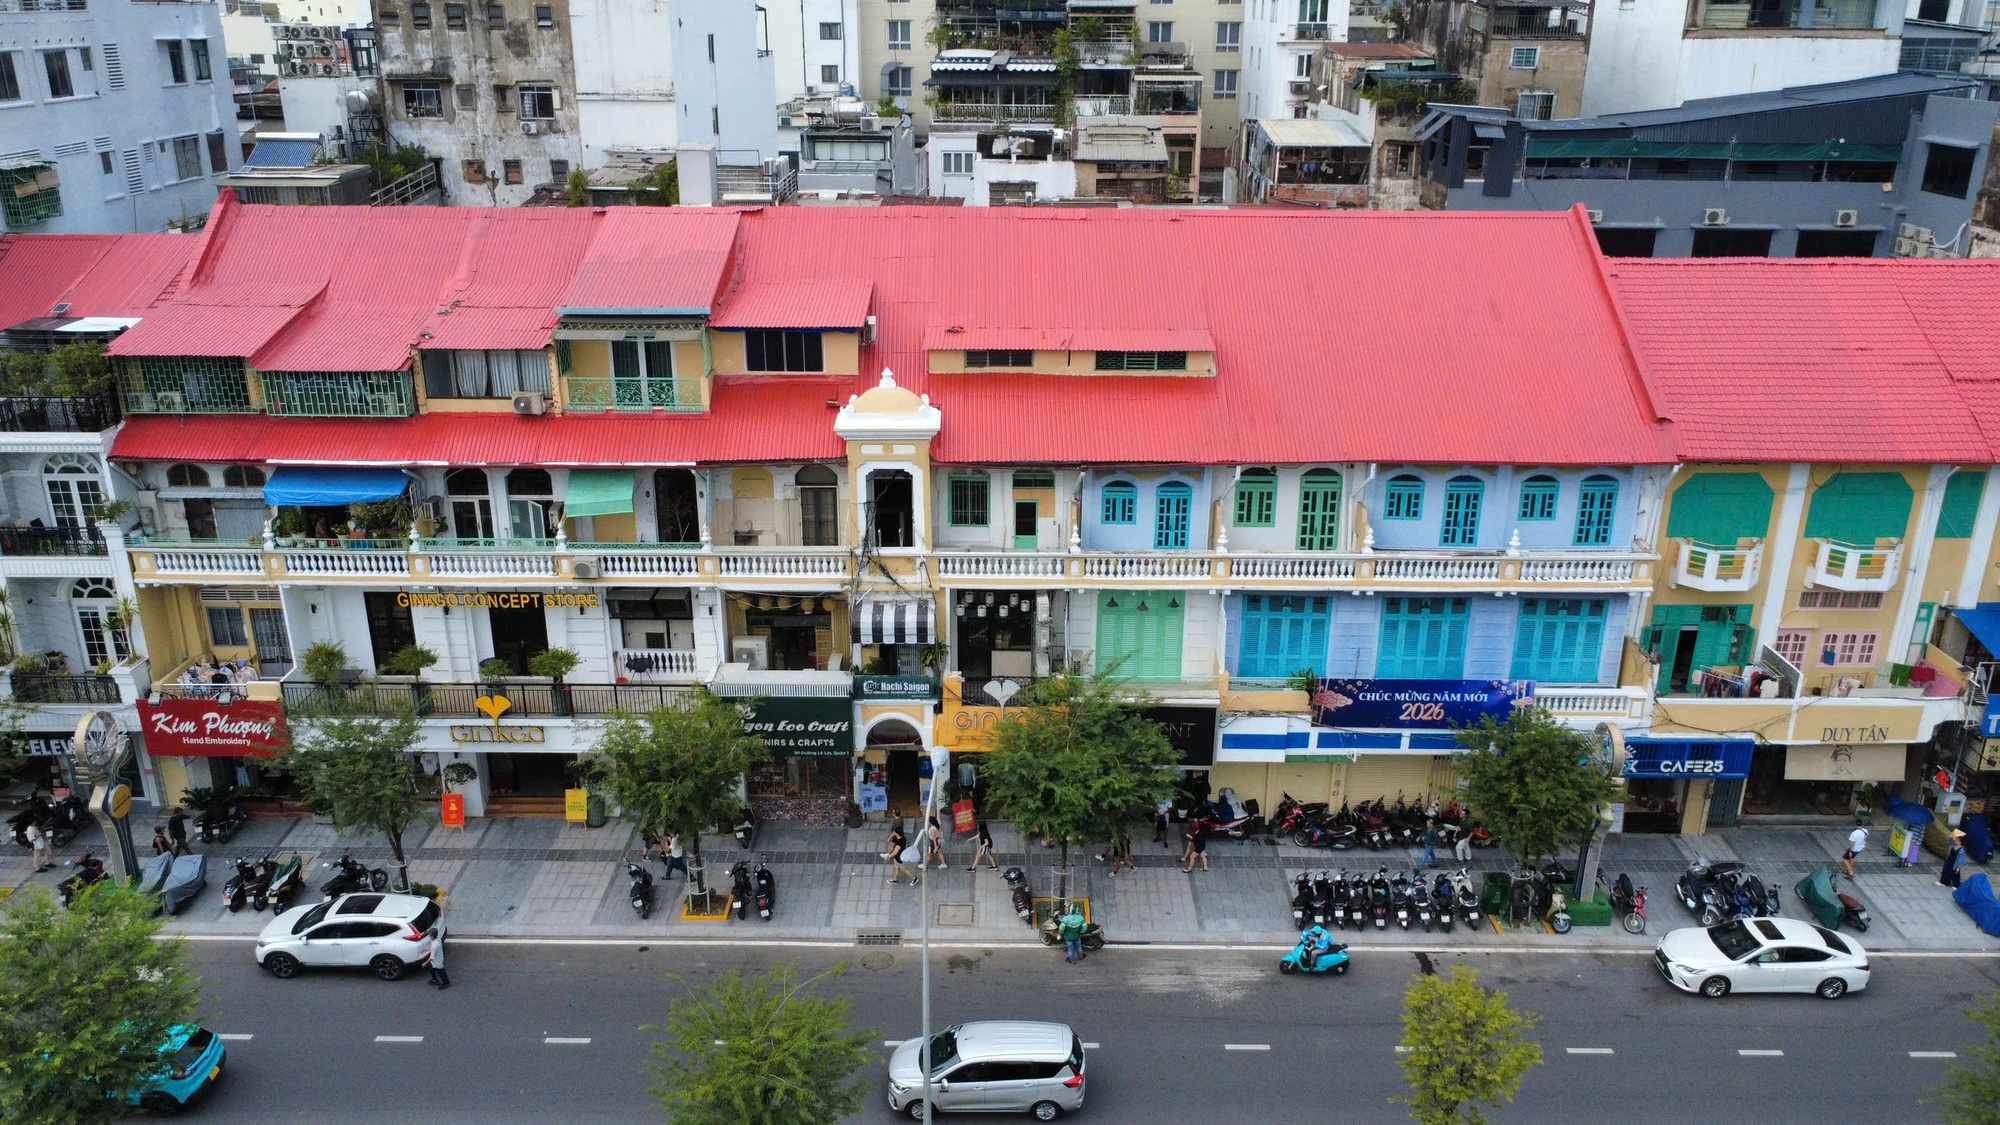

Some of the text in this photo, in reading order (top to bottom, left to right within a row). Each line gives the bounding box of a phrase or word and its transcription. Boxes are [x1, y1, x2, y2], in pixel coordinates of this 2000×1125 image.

[397, 593, 599, 608] GINKGO CONCEPT STORE
[881, 681, 902, 691] Hachi
[904, 681, 930, 692] Saigon
[1358, 690, 1489, 702] CHÚC MỪNG NĂM MỚI
[1398, 702, 1445, 720] 2026
[151, 712, 274, 740] Kim Phượng
[777, 720, 805, 732] Eco
[807, 720, 849, 733] Craft
[1821, 723, 1890, 742] DUY TÂN
[183, 736, 251, 746] Hand Embroidery
[788, 738, 795, 747] &
[797, 738, 835, 747] CRAFTS
[1660, 760, 1724, 773] CAFE25
